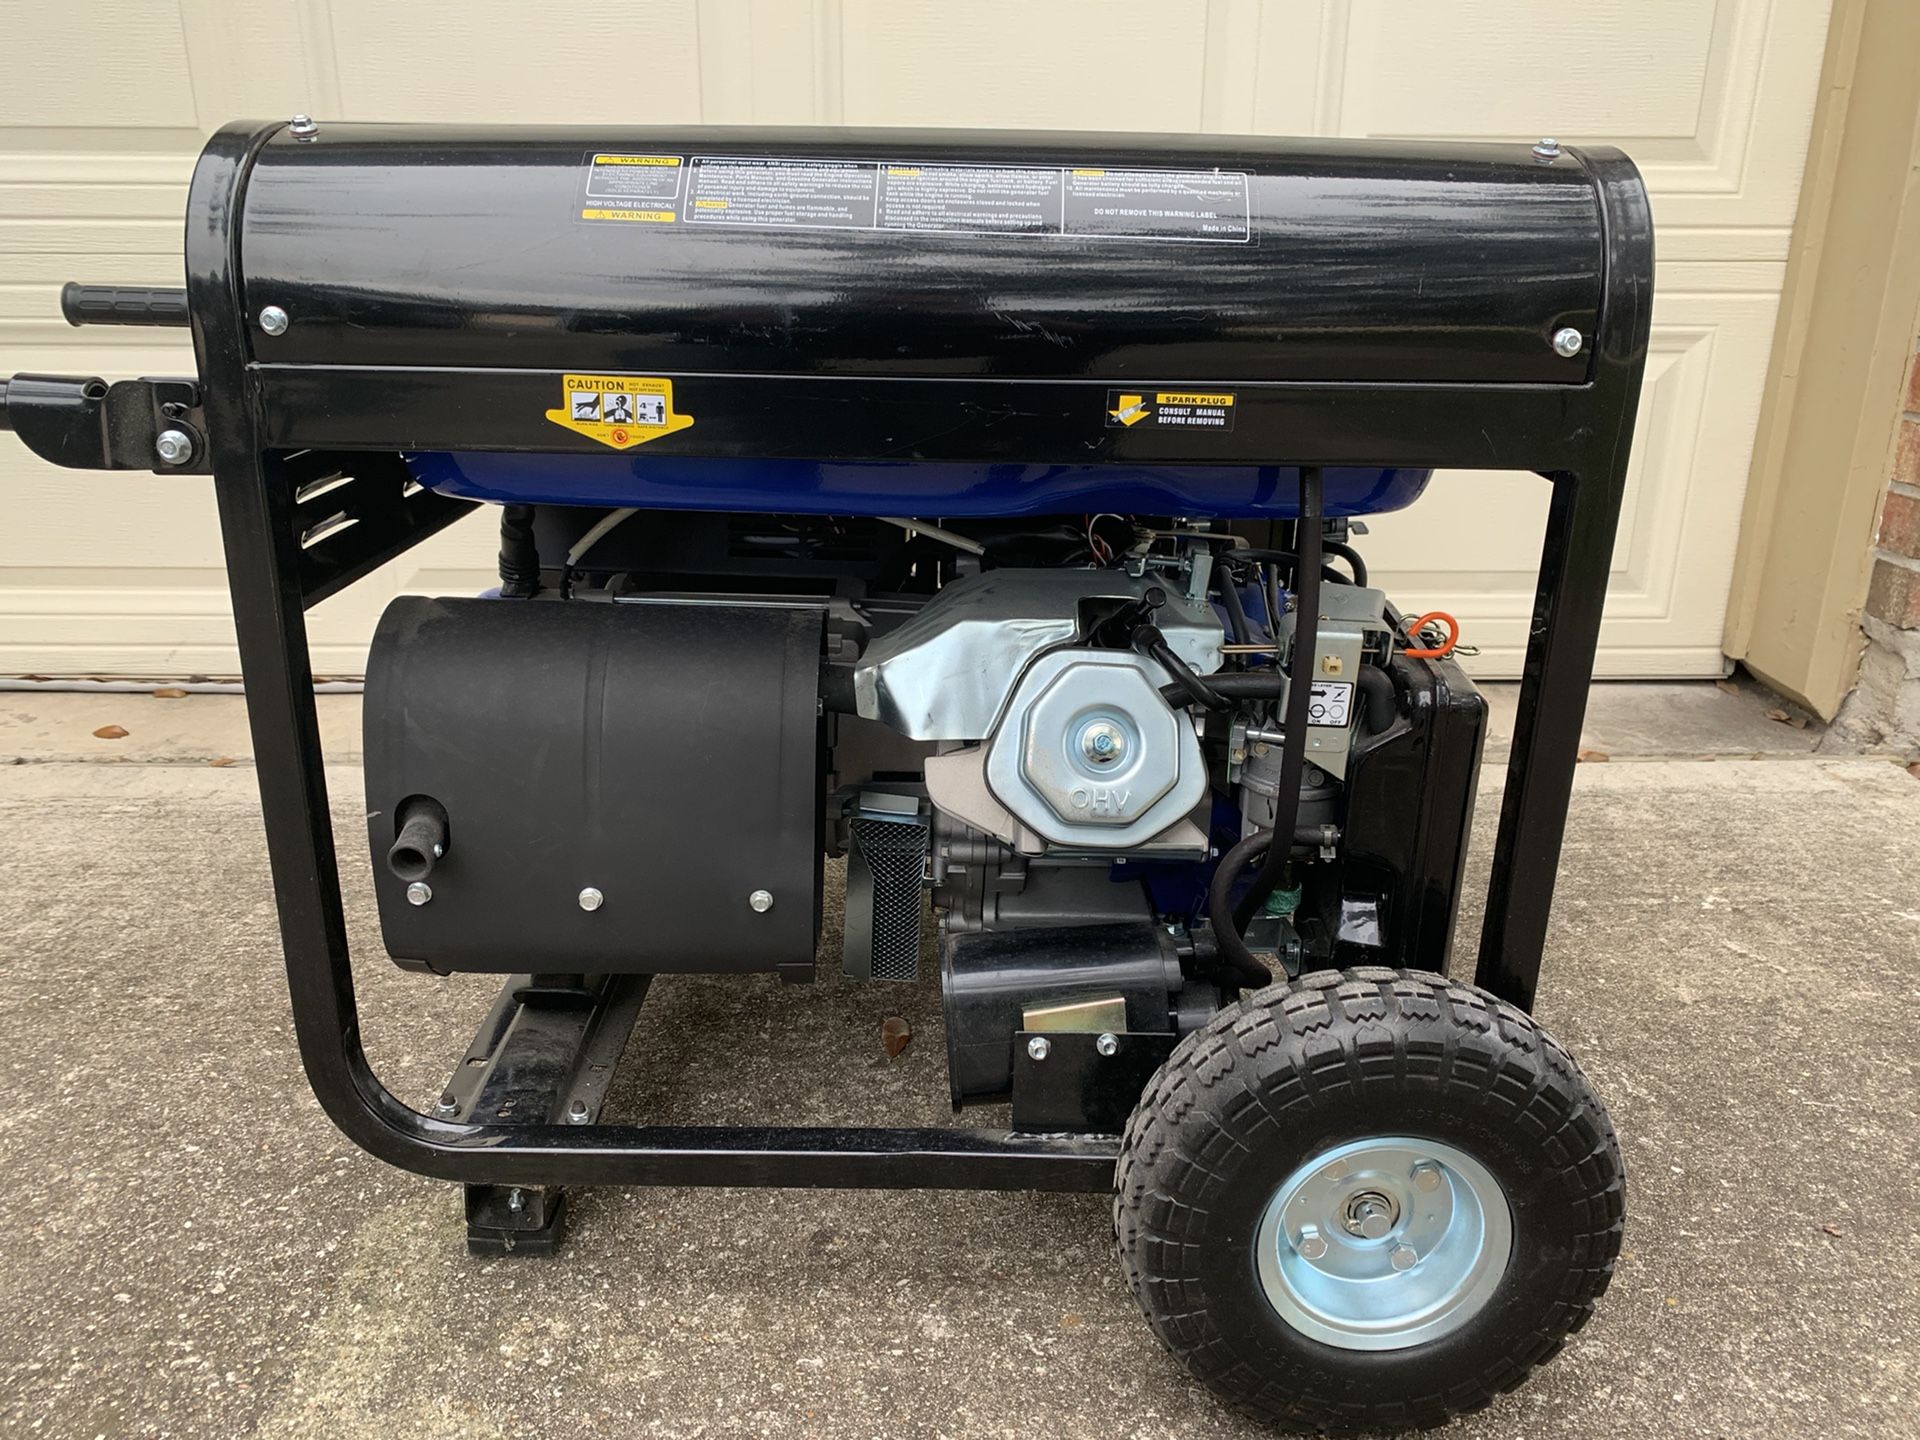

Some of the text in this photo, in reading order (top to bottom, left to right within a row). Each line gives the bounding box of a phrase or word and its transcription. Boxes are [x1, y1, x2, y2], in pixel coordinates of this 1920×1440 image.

[611, 212, 661, 220] WARNING
[567, 379, 624, 391] CAUTION
[1158, 407, 1225, 416] CONSULT MANUAL
[1158, 416, 1225, 426] BEFORE REMOVING
[1070, 786, 1132, 811] OHV
